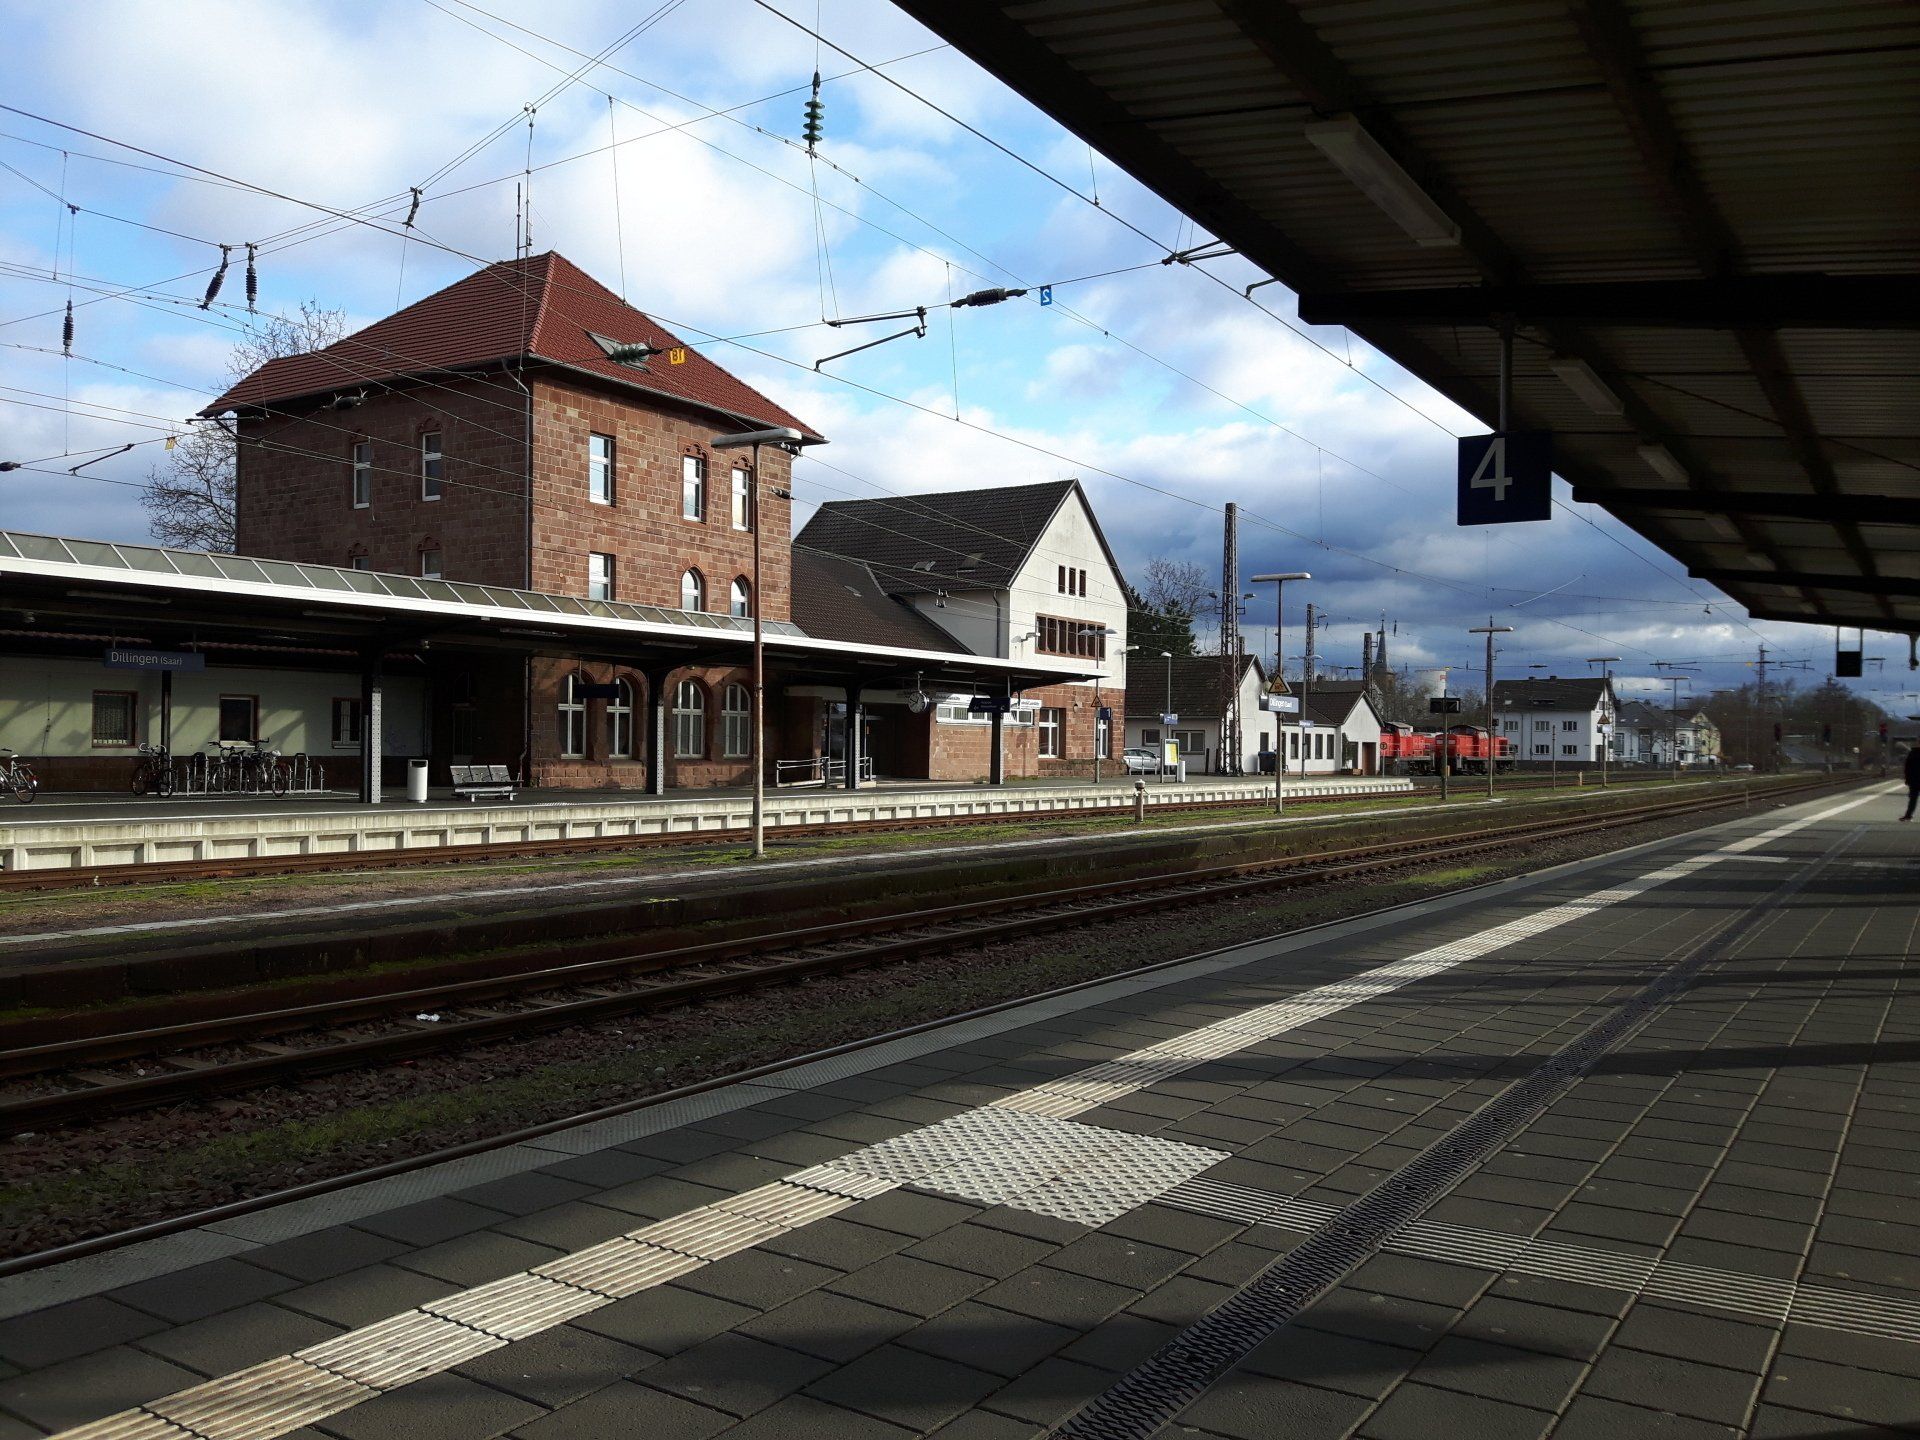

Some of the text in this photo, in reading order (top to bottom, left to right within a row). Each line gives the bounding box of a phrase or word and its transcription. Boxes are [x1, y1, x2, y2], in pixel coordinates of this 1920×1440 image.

[1470, 437, 1513, 502] 4
[111, 651, 182, 666] Dillingen (Saar)
